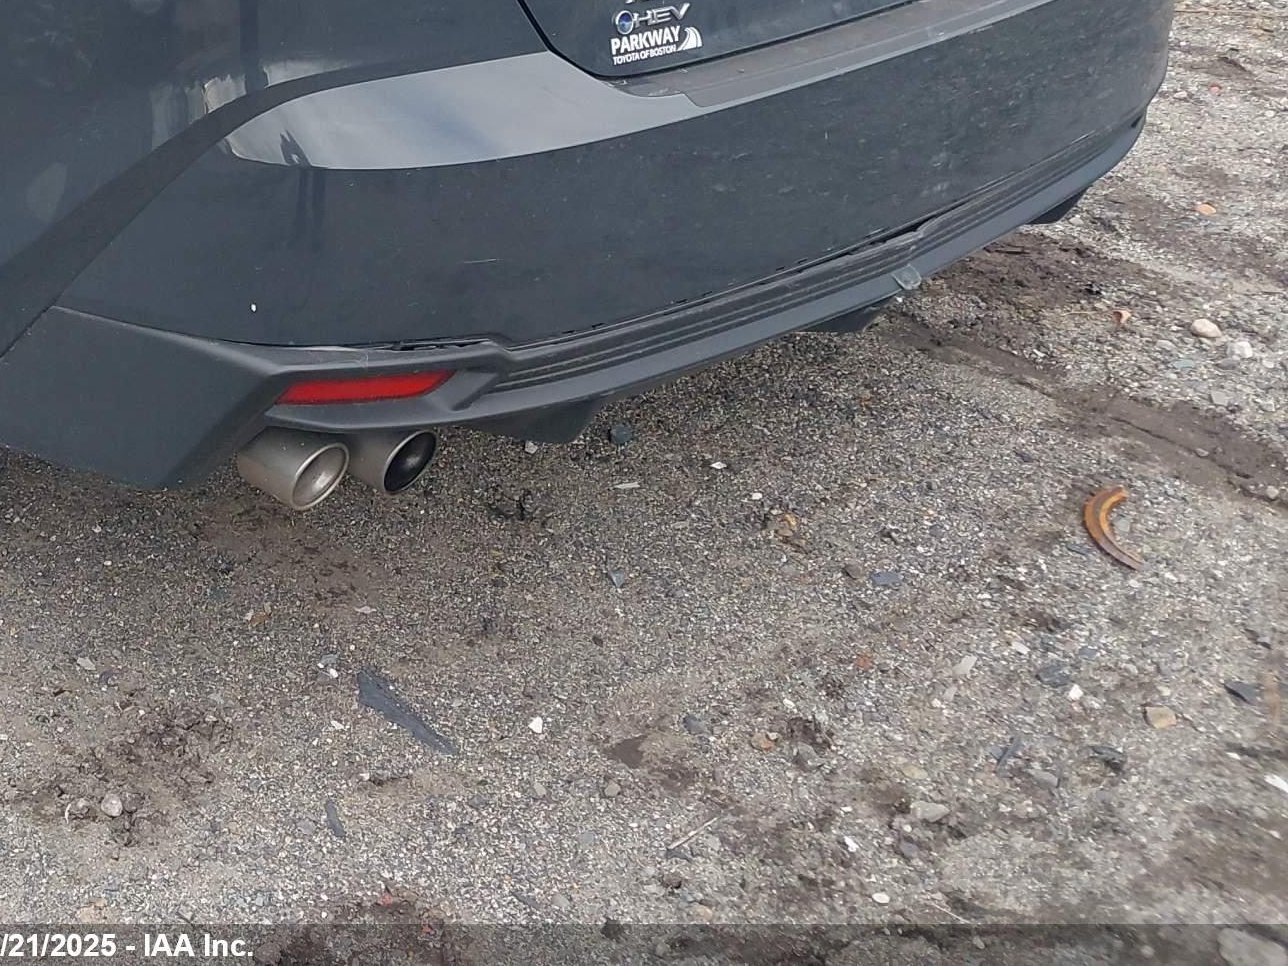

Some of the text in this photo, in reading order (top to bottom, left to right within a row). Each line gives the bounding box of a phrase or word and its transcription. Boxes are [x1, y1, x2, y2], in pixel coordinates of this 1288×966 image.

[611, 25, 681, 55] PARKWAY
[612, 44, 677, 66] TOYOTA OF BOSTON
